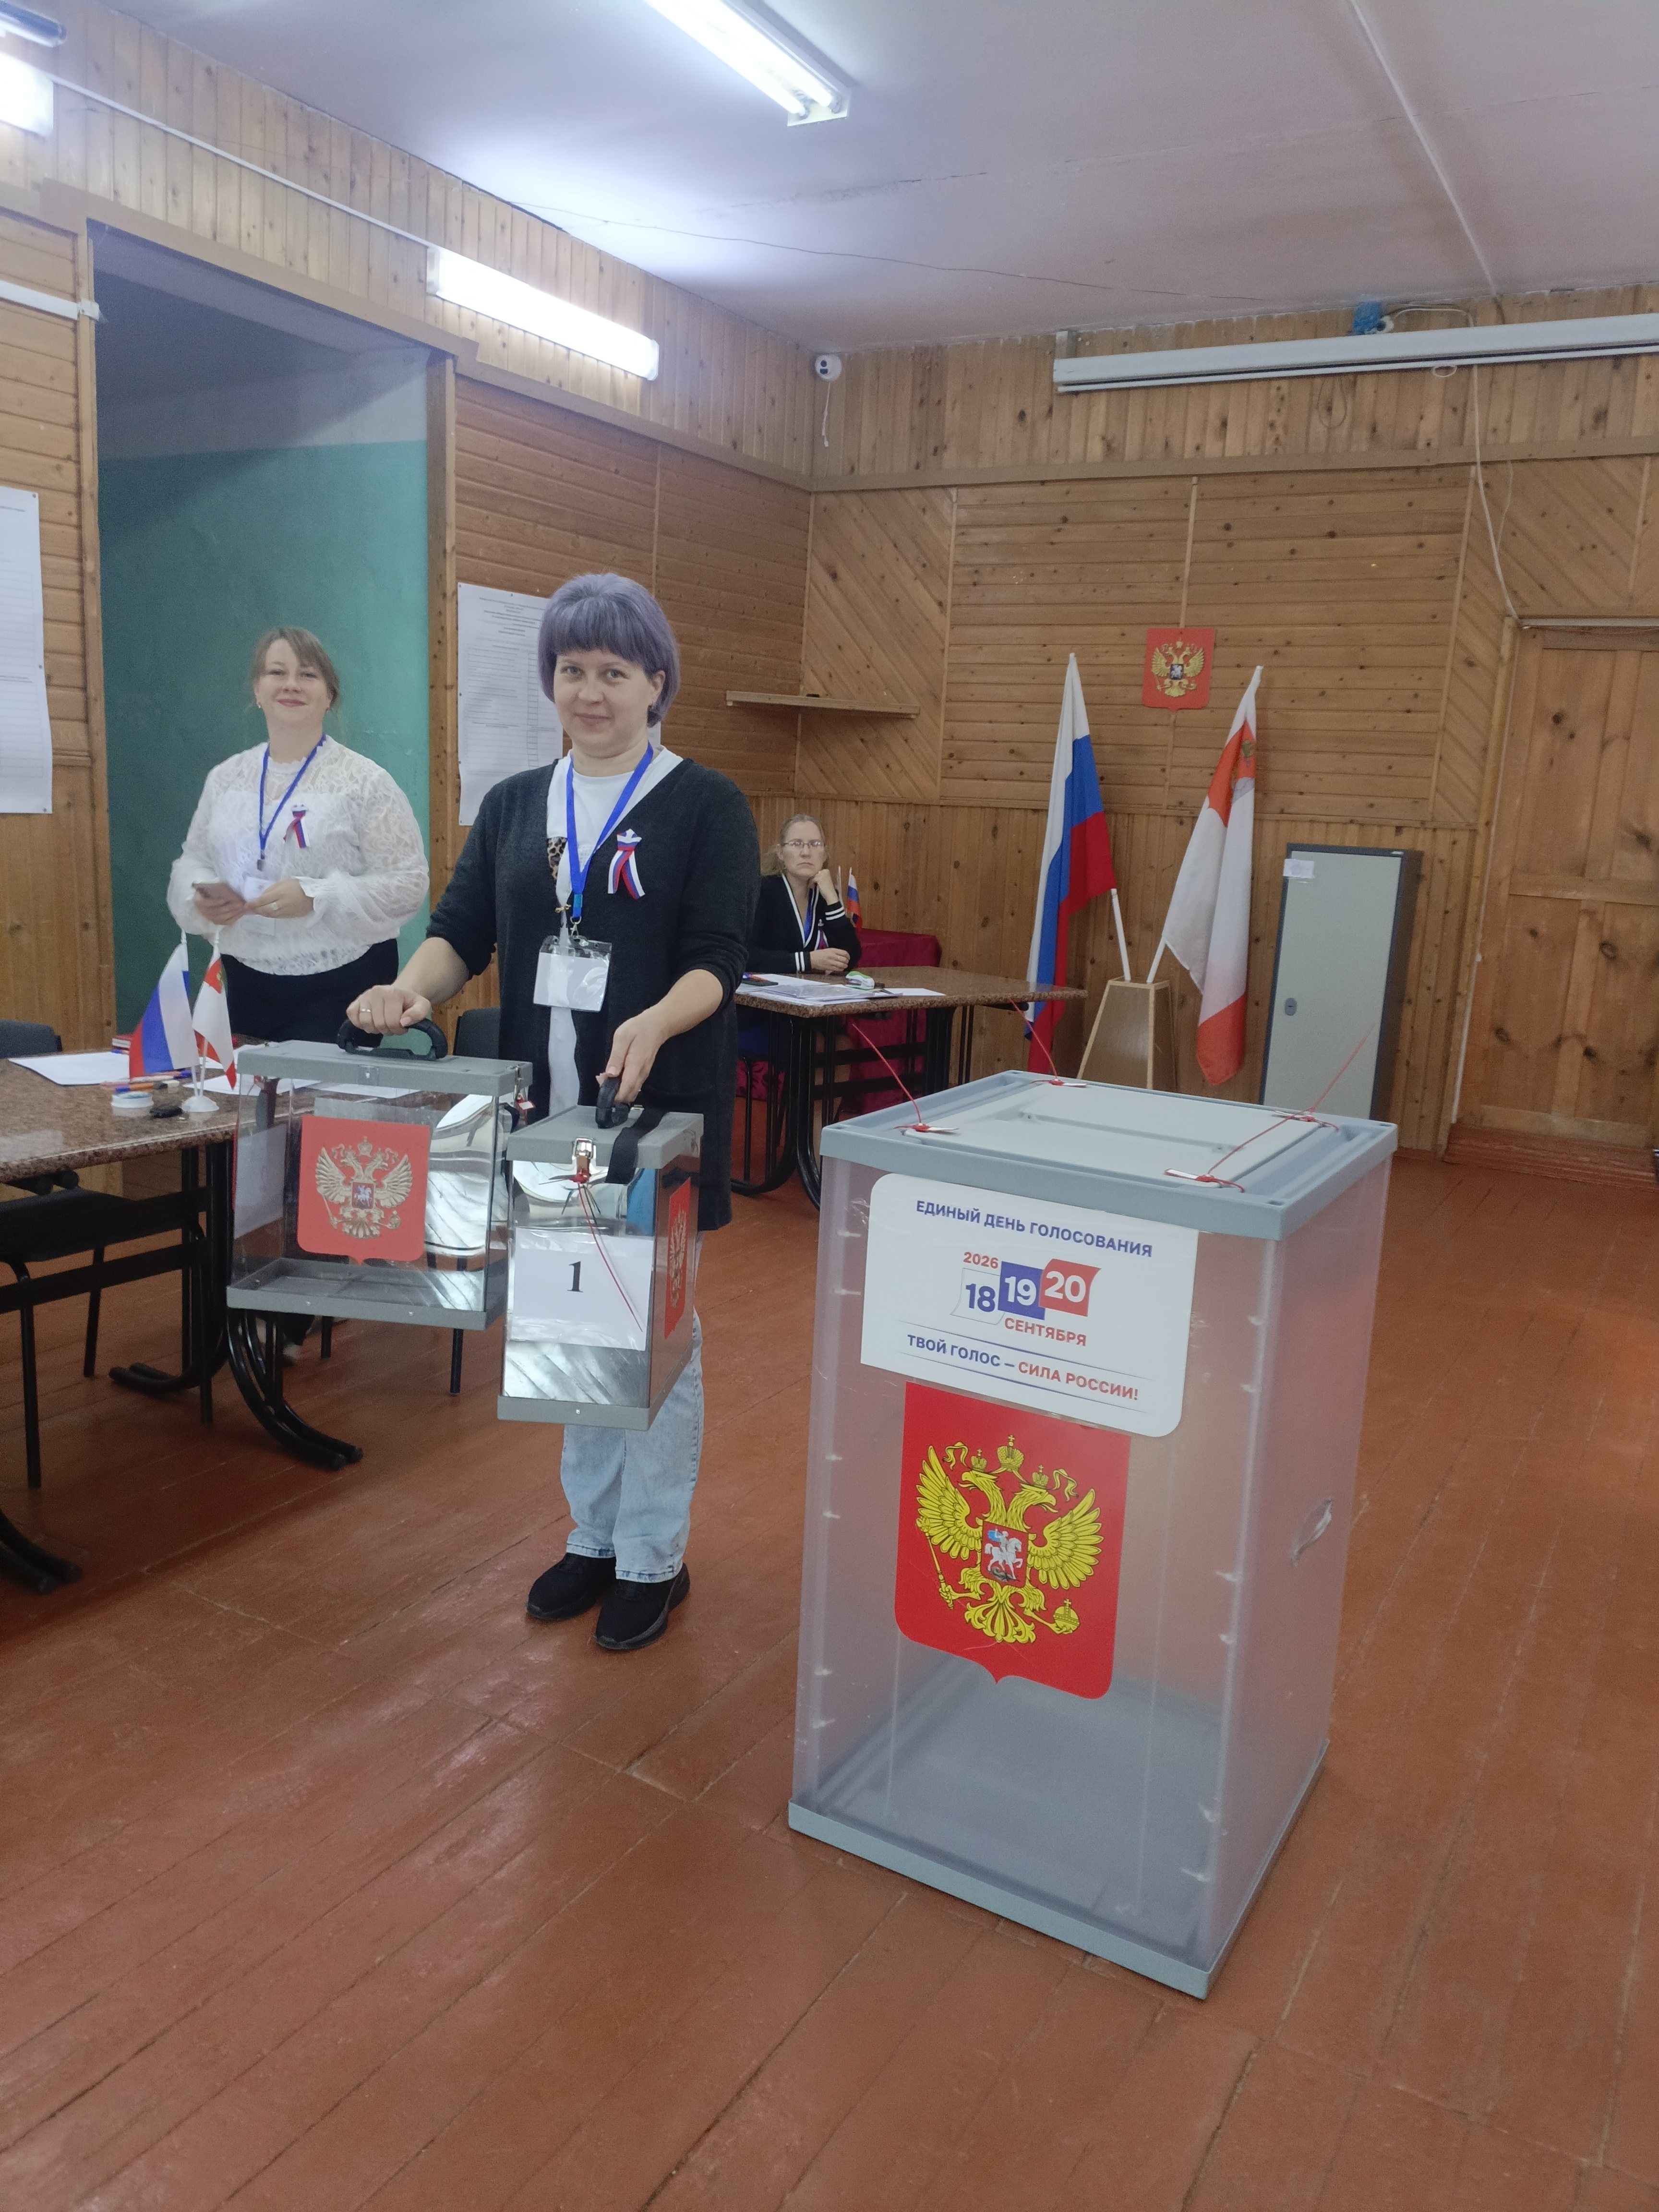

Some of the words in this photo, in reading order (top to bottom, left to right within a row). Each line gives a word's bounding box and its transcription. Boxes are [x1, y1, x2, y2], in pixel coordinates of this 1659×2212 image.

[916, 1200, 981, 1224] ЕДИНЫЙ
[984, 1213, 1025, 1232] ДЕНЬ
[1030, 1222, 1153, 1258] ГОЛОСОВАНИЯ
[567, 1262, 583, 1292] 1
[963, 1251, 999, 1269] 2026
[965, 1283, 996, 1312] 18
[1004, 1276, 1036, 1306] 19
[1044, 1271, 1086, 1302] 20
[1004, 1317, 1087, 1346] СЕНТЯБРЯ
[907, 1334, 947, 1354] ТВОЙ
[950, 1345, 1001, 1367] ГОЛОС
[1018, 1361, 1061, 1382] СИЛА
[1066, 1372, 1138, 1401] РОССИИ!
